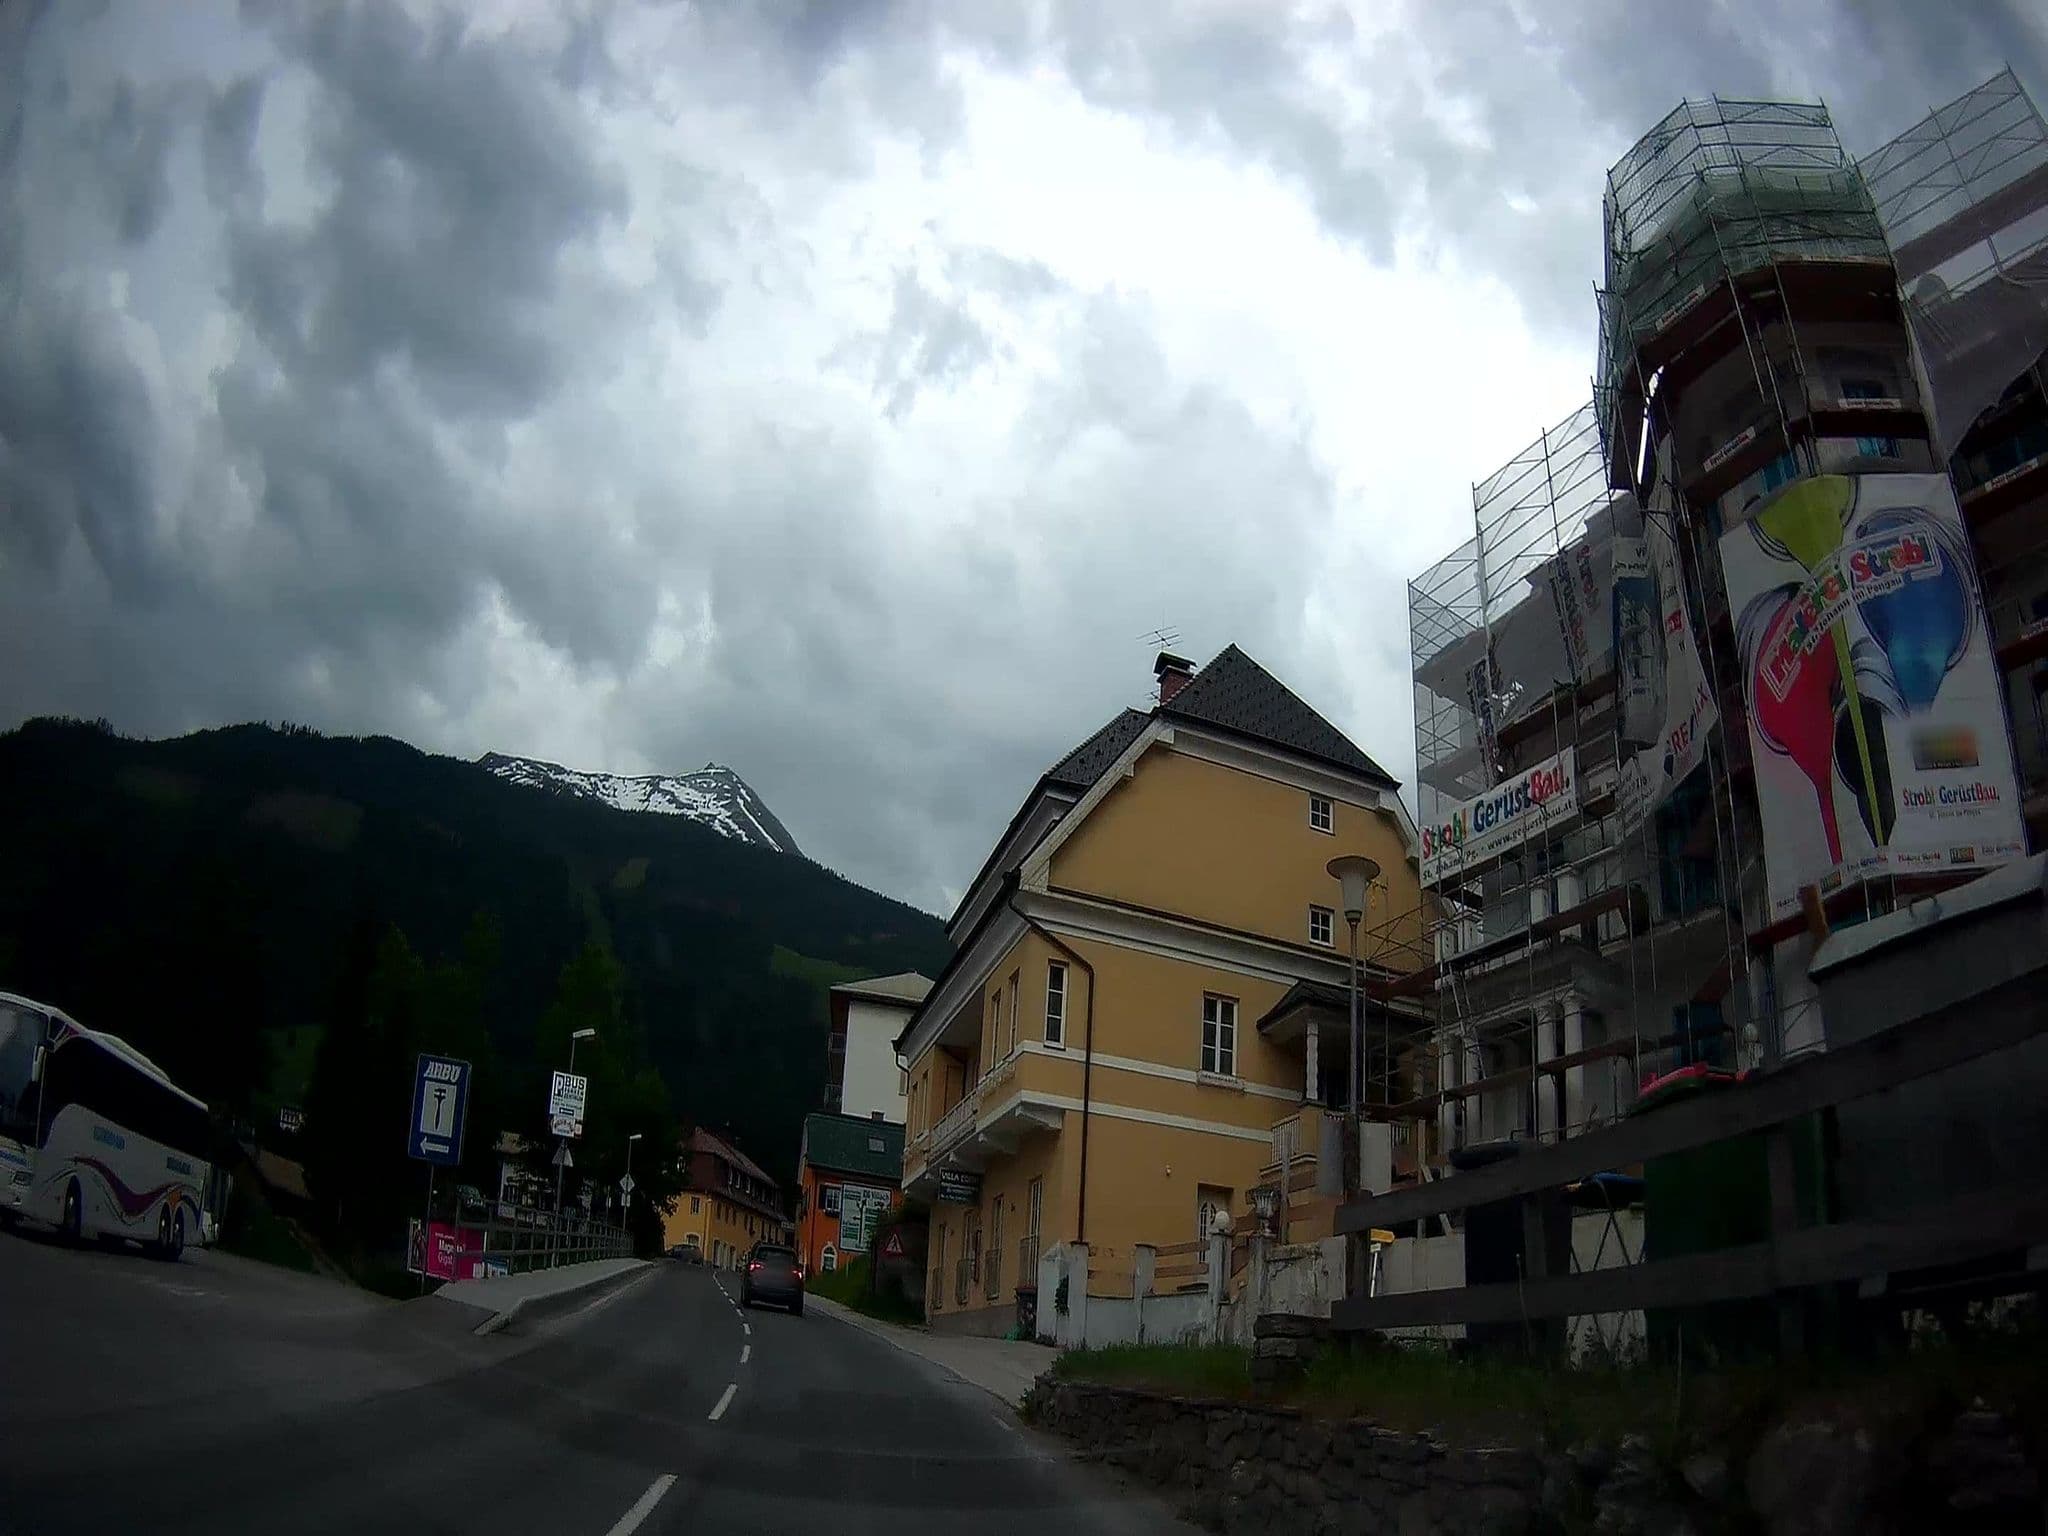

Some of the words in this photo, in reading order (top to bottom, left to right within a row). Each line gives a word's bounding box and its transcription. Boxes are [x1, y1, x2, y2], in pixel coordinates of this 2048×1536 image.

[1850, 531, 1932, 584] Strobl
[1903, 786, 1936, 806] Strobl
[565, 1076, 585, 1090] BUS
